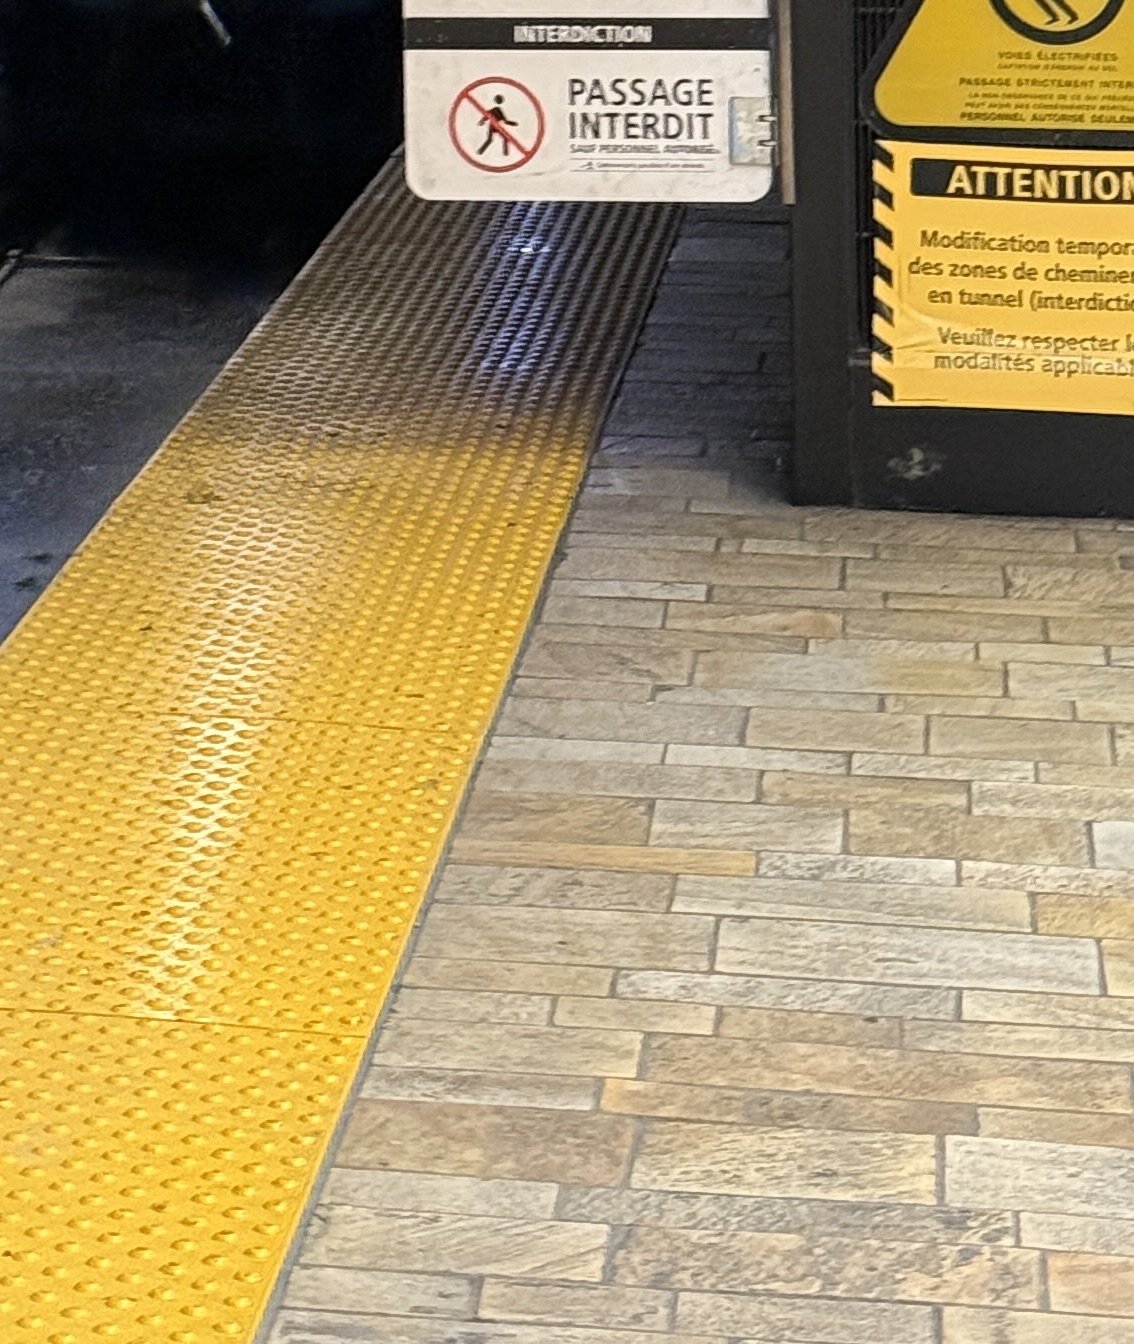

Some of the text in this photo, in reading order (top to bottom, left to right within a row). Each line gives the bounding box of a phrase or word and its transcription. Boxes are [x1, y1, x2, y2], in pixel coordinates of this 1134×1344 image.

[513, 24, 653, 44] INTERDICTION
[997, 50, 1032, 60] VOIES
[568, 78, 714, 106] PASSAGE
[959, 77, 1011, 87] PASSAGE
[1016, 78, 1094, 88] STRICTEMENT
[568, 112, 714, 140] INTERDIT
[960, 111, 1026, 122] PERSONNEL
[920, 229, 1134, 260] Modification tempor
[908, 256, 1134, 284] des zones de chemine
[927, 289, 952, 304] en
[958, 289, 1024, 308] tunnel
[937, 326, 1134, 354] Veuillez respecter l
[934, 353, 1035, 372] modalités
